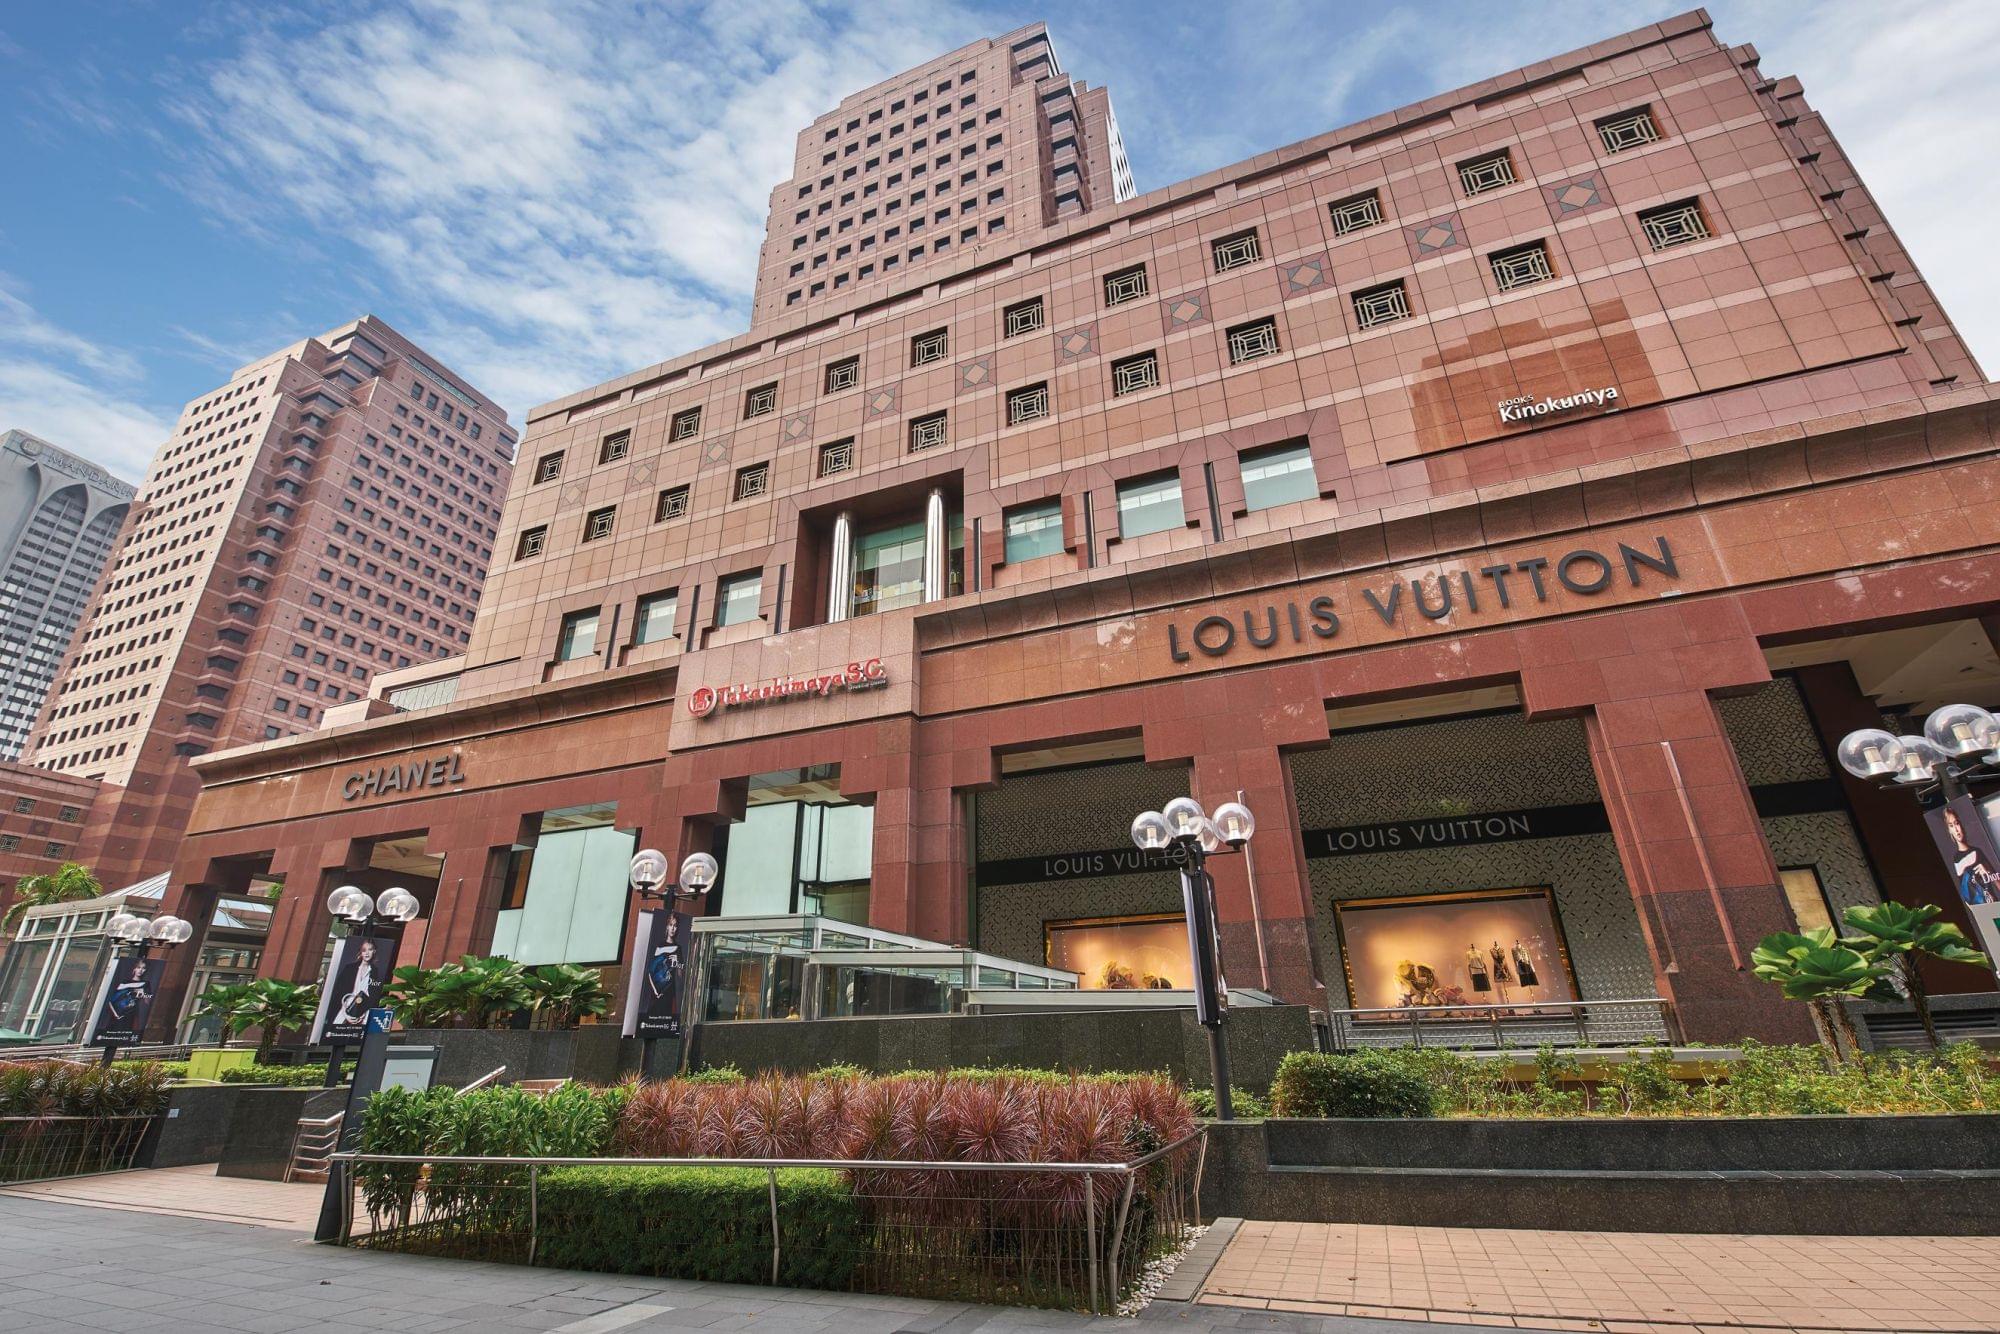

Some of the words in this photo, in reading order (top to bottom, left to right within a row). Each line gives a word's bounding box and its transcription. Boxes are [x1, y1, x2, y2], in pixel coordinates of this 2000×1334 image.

[1498, 394, 1534, 408] BOOKS
[1500, 387, 1618, 423] Kinokuniya
[1168, 596, 1340, 662] LOUIS
[1363, 536, 1679, 627] VUITTON
[716, 675, 846, 705] Takashimaya
[342, 753, 465, 801] CHANEL
[1327, 827, 1401, 852] LOUIS
[1409, 815, 1531, 844] VUITTON
[1045, 855, 1104, 877] LOUIS
[671, 959, 685, 968] Dior
[136, 990, 153, 999] Dior
